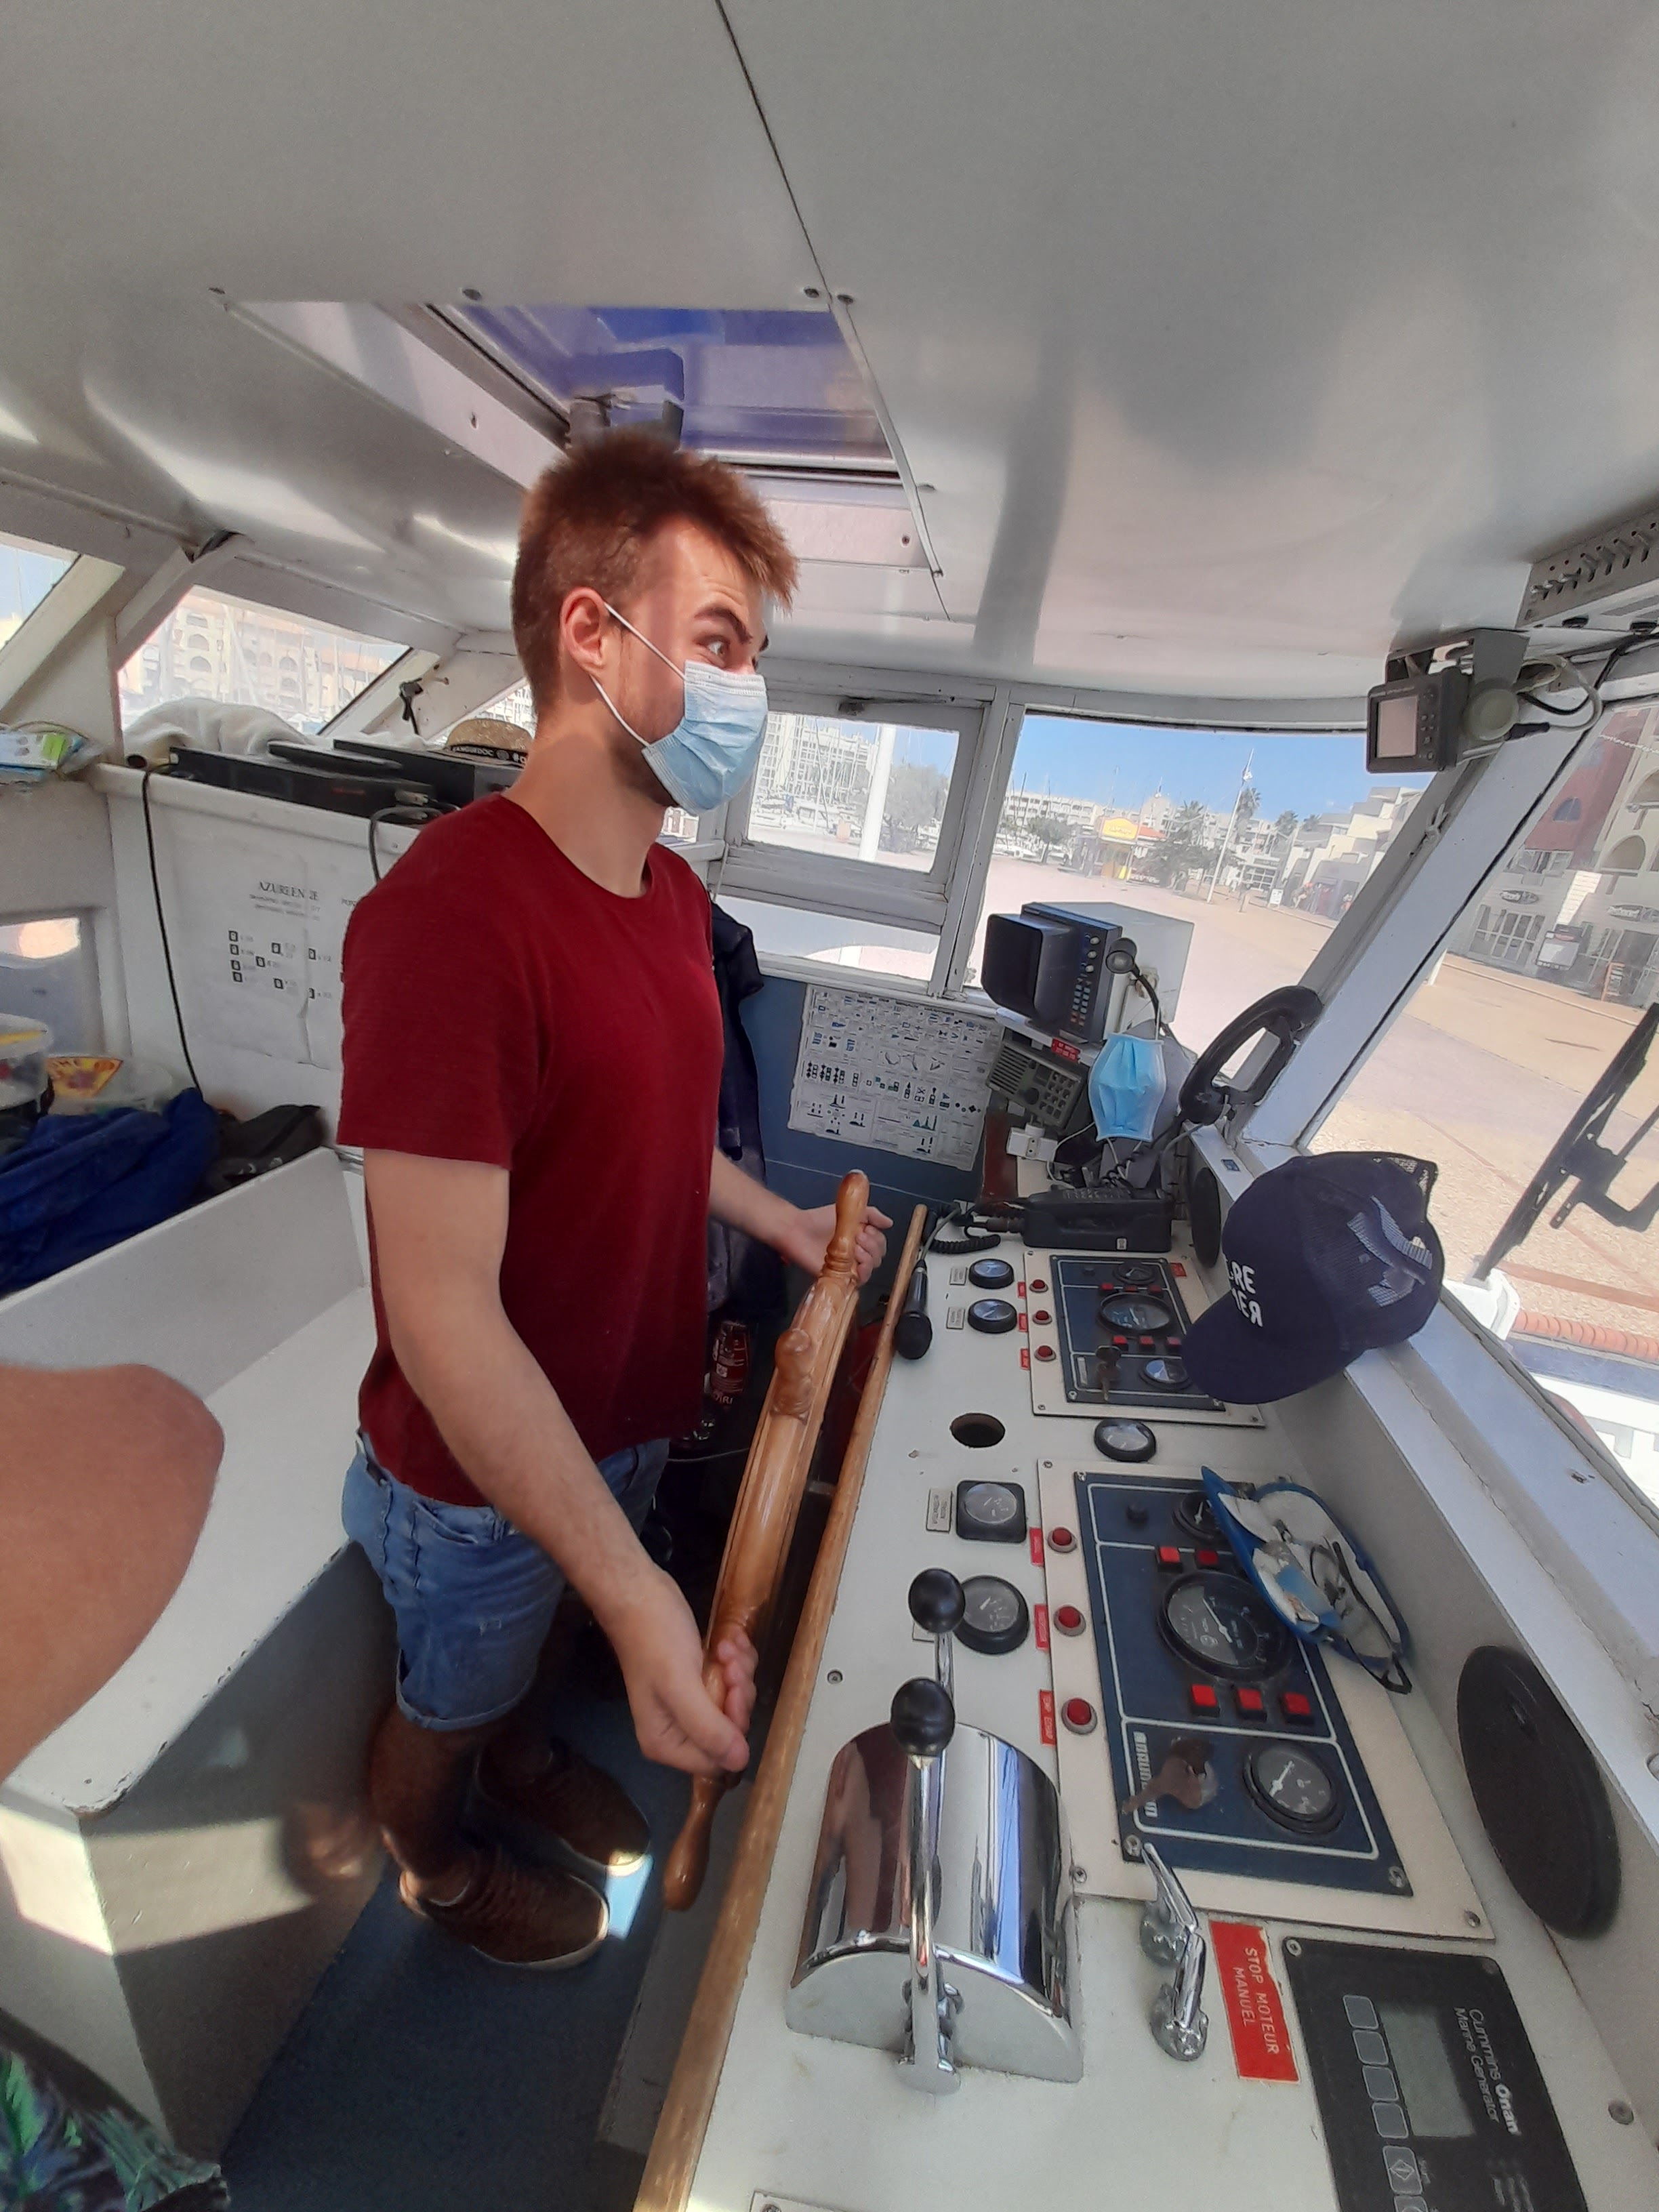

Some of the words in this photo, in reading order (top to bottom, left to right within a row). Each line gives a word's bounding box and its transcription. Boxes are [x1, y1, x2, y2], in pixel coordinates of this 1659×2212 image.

[1233, 1967, 1256, 2028] MANUEL
[1245, 1947, 1265, 1984] STOP
[1256, 1992, 1280, 2055] MOTEUR
[1453, 2007, 1477, 2053] Marine
[1471, 2054, 1500, 2123] Generator
[1469, 2008, 1502, 2081] Cummins
[1495, 2083, 1521, 2135] Onan
